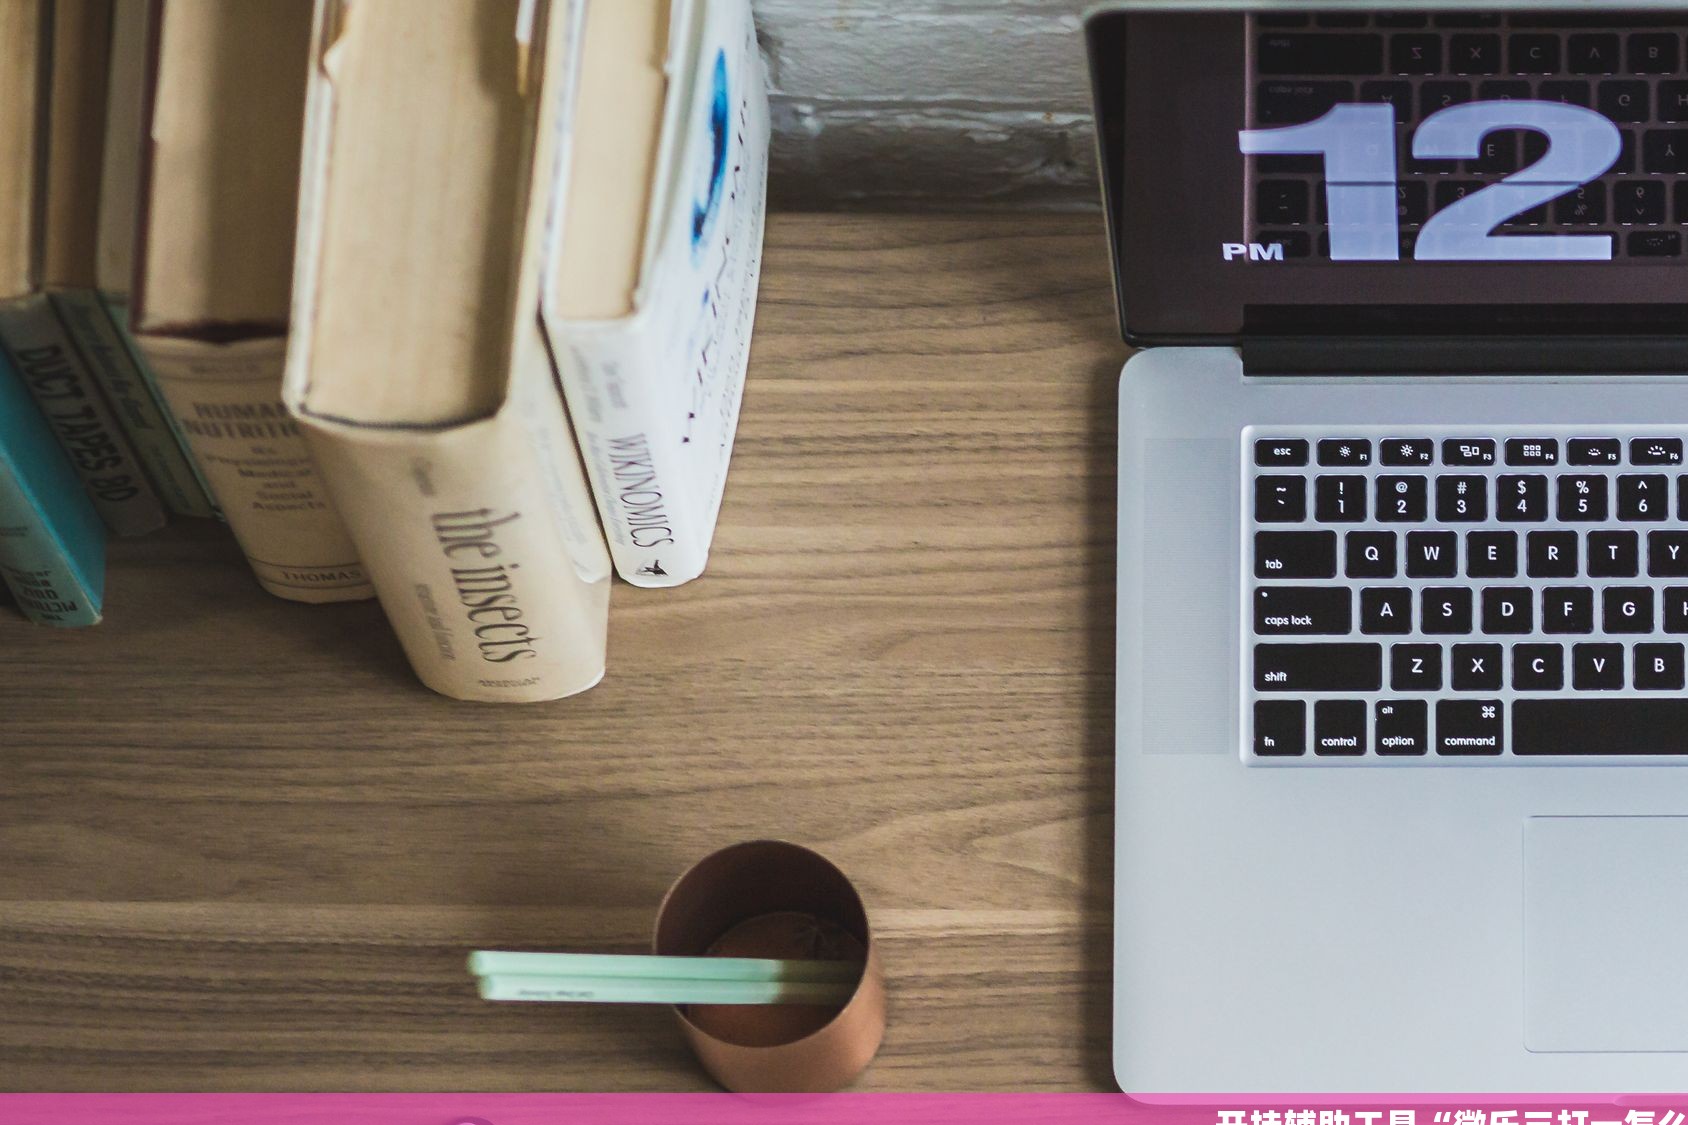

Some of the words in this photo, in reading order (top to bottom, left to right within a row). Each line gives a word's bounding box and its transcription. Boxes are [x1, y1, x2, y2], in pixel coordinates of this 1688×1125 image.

[1238, 100, 1623, 262] 12
[1222, 243, 1284, 262] PM
[20, 346, 84, 398] DUCT
[52, 406, 121, 472] TAPES
[1273, 447, 1292, 456] esc
[1359, 453, 1368, 461] F1
[1420, 453, 1430, 461] F2
[1483, 453, 1493, 461] F3
[1545, 453, 1555, 461] F4
[1607, 453, 1617, 461] F5
[1669, 453, 1680, 461] F6
[606, 432, 674, 547] WIKINOMICS
[1337, 499, 1345, 514] 1
[1396, 499, 1407, 514] 2
[1456, 499, 1467, 514] 3
[1516, 498, 1528, 513] 4
[1577, 498, 1588, 513] 5
[1638, 498, 1648, 513] 6
[432, 507, 521, 559] the
[1364, 545, 1379, 561] Q
[1423, 546, 1440, 561] W
[1487, 545, 1497, 561] E
[1547, 545, 1559, 561] R
[1608, 545, 1619, 560] T
[1668, 544, 1680, 560] Y
[1264, 558, 1283, 570] tab
[450, 563, 541, 663] insects
[1380, 602, 1394, 617] A
[1442, 602, 1453, 617] S
[1501, 601, 1515, 617] D
[1563, 601, 1573, 617] F
[1622, 601, 1636, 617] G
[1264, 616, 1290, 627] caps
[1291, 614, 1313, 626] lock
[1411, 658, 1424, 674] Z
[1471, 657, 1485, 673] X
[1531, 657, 1545, 673] C
[1592, 657, 1606, 673] V
[1654, 657, 1665, 673] B
[1264, 671, 1288, 682] shift
[1381, 705, 1394, 715] alt
[1263, 736, 1275, 747] fn
[1321, 736, 1357, 747] control
[1381, 735, 1415, 748] option
[1444, 735, 1496, 746] command
